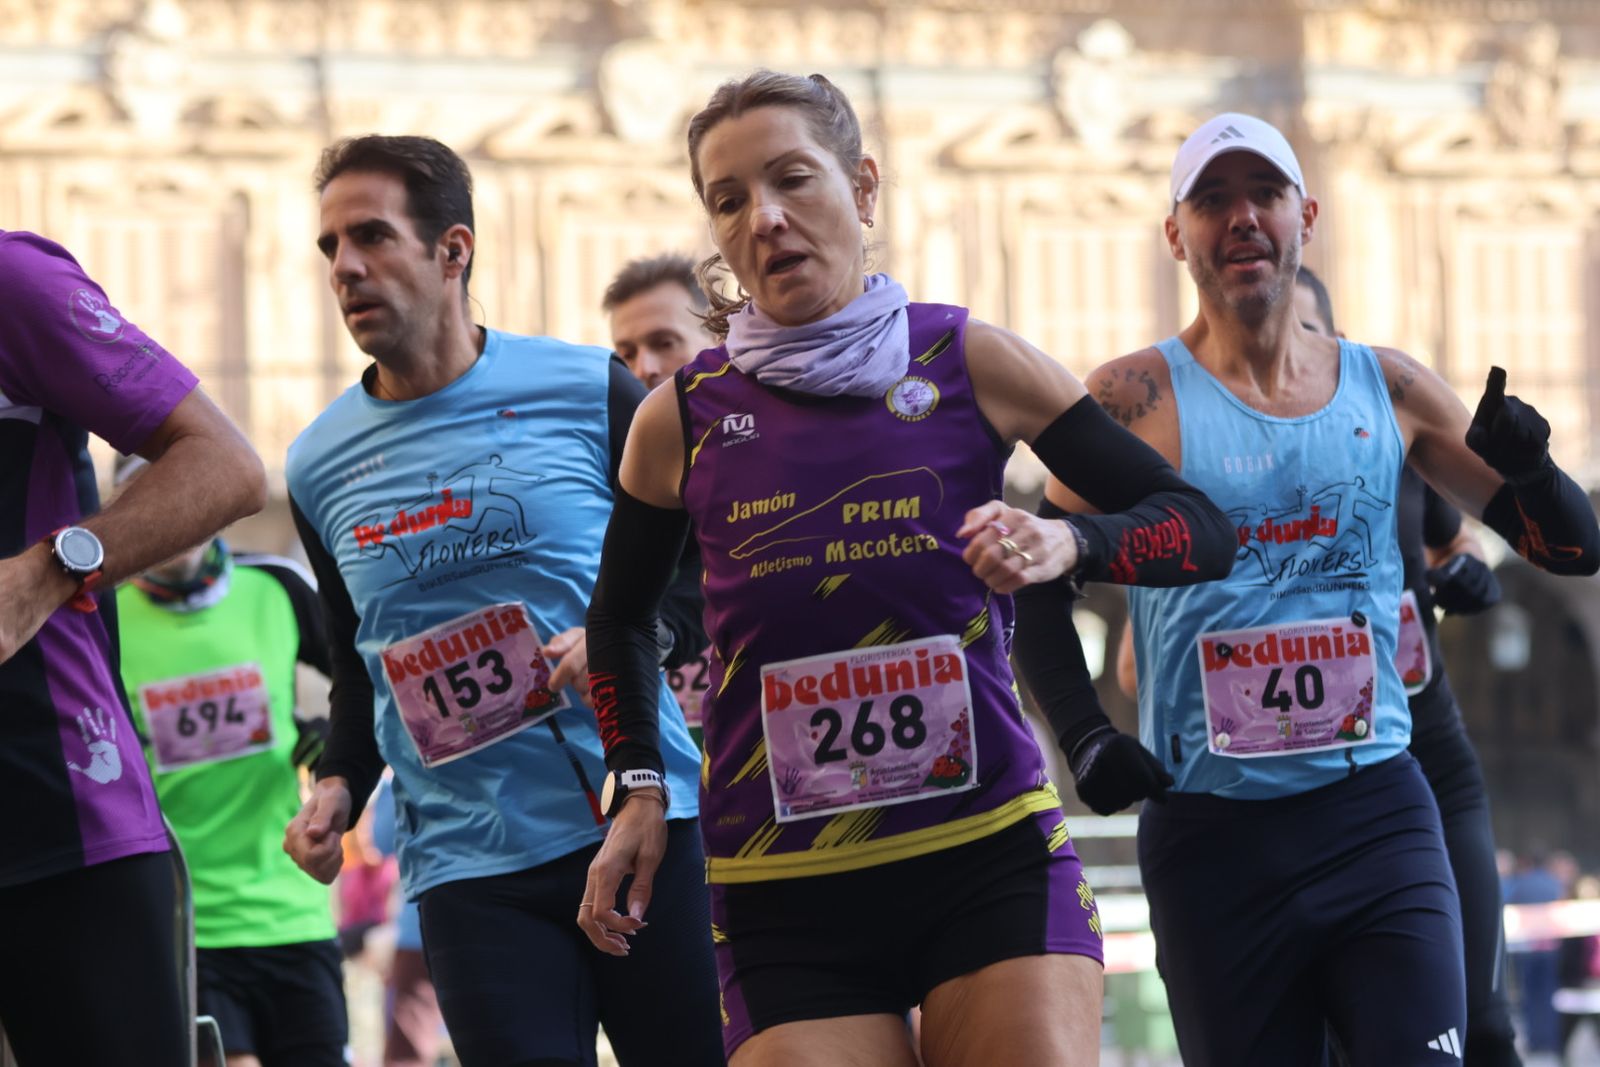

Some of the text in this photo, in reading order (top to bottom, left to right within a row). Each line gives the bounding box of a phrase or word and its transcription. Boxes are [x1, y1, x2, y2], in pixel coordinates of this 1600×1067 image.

[726, 490, 796, 523] Jamón
[842, 496, 921, 524] PRIM
[1236, 505, 1337, 547] edunia
[418, 528, 516, 572] FLOWERS
[750, 555, 813, 578] Atletismo
[825, 533, 940, 564] Macotera
[1278, 550, 1363, 582] FLOWERS
[384, 608, 529, 685] bedunia
[1202, 627, 1370, 673] bedunia
[144, 669, 262, 710] bedunia
[422, 650, 513, 718] 153
[764, 649, 963, 713] bedunia
[1261, 665, 1325, 712] 40
[177, 697, 245, 737] 694
[810, 694, 927, 765] 268
